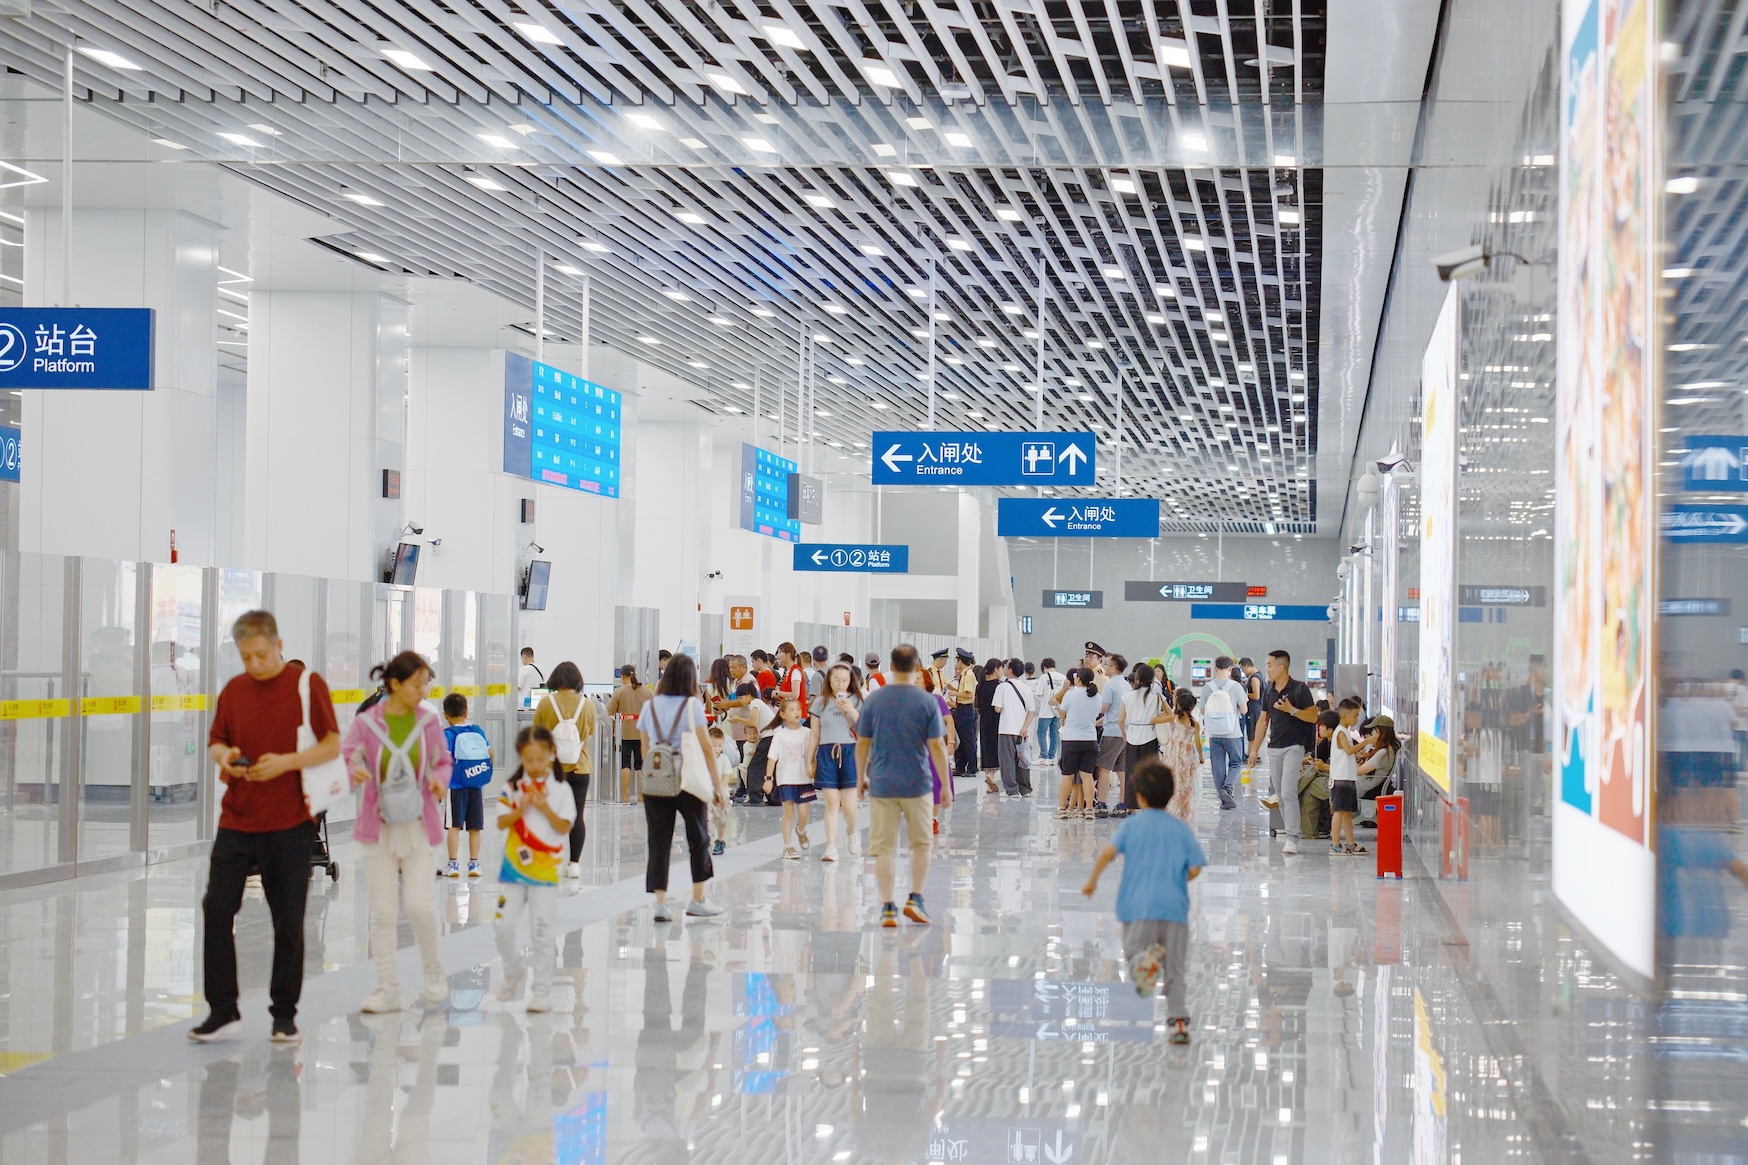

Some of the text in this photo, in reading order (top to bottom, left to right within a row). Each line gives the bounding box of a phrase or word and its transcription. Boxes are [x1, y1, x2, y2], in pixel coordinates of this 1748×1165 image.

[34, 324, 97, 356] 站台
[33, 358, 95, 373] Platform
[916, 442, 983, 464] 入闸处
[916, 465, 963, 475] Entrance
[1067, 505, 1116, 522] 入闸处
[1067, 522, 1102, 530] Entrance
[867, 550, 891, 562] 站台
[1187, 585, 1213, 595] 卫生间
[1067, 593, 1091, 602] 卫生间
